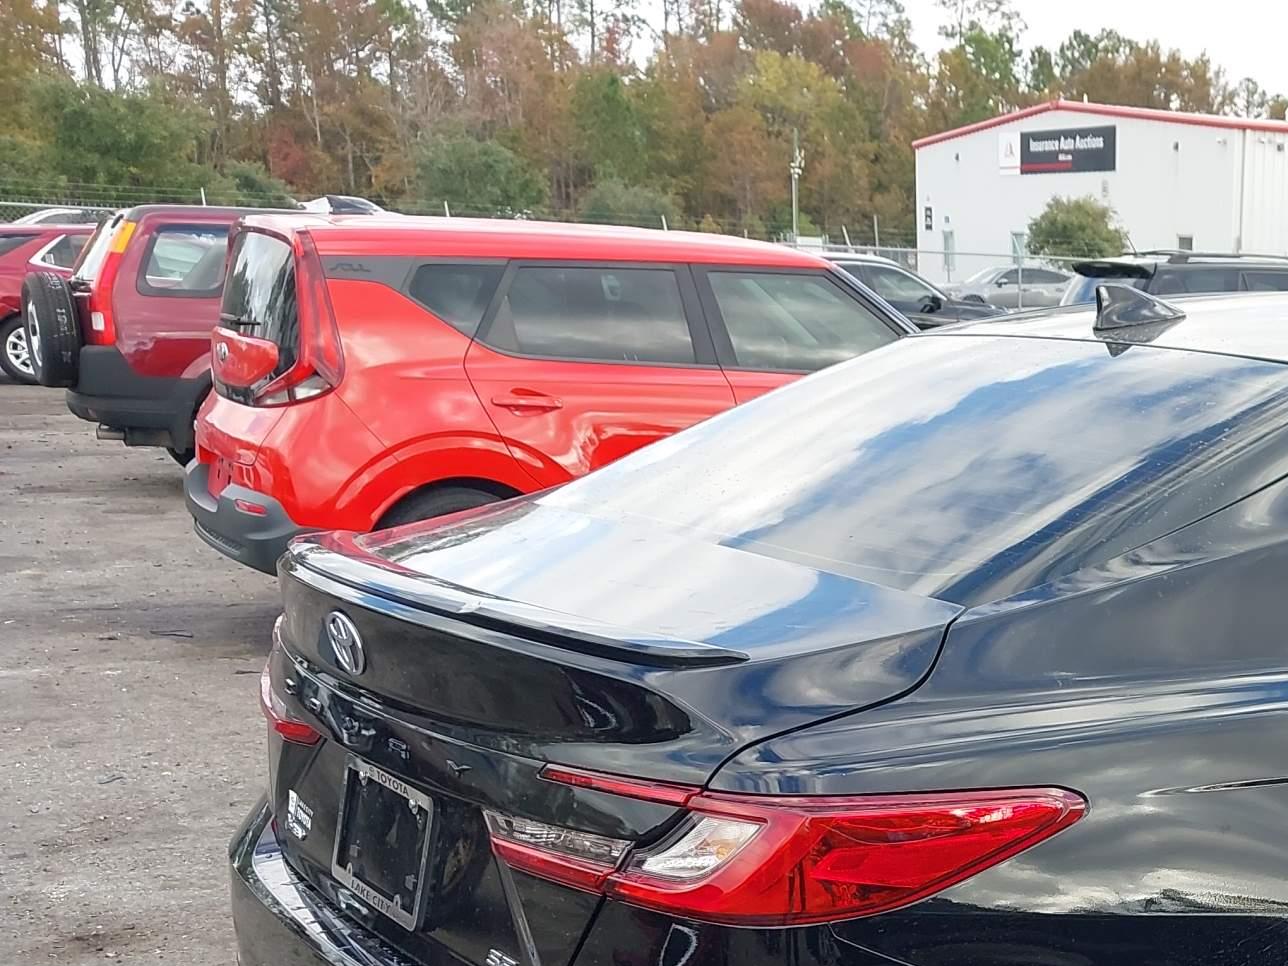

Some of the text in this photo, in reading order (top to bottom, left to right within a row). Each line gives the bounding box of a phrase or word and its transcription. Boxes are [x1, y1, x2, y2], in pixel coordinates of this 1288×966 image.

[1029, 134, 1104, 152] Insurance Auto Auctions
[376, 769, 410, 797] TOYOTA
[351, 878, 392, 915] LAKE CITY
